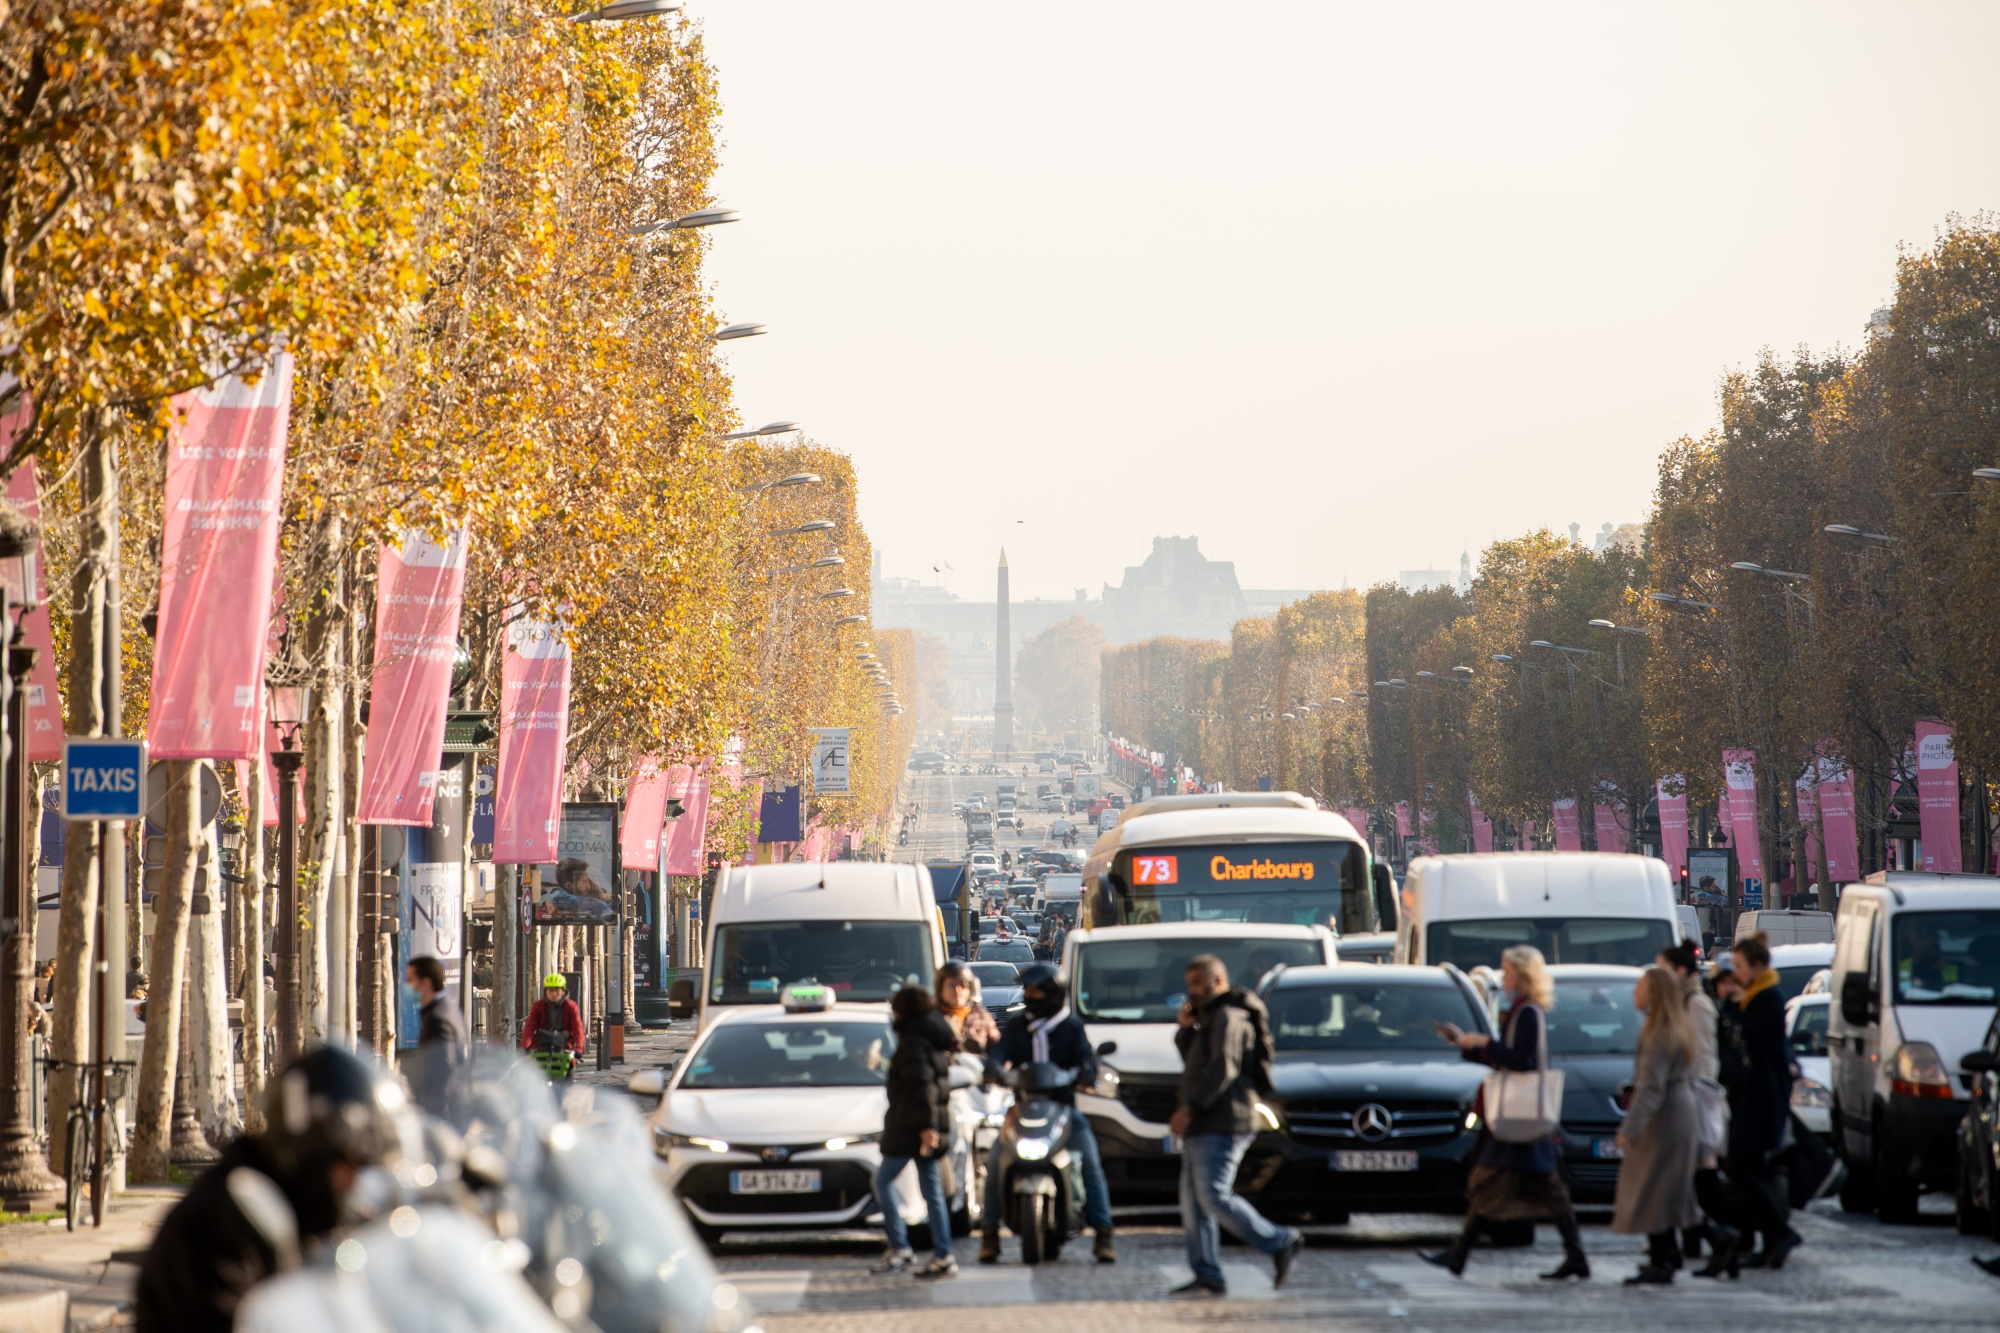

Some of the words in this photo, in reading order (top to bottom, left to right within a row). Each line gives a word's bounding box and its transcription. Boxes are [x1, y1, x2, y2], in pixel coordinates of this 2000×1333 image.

[1925, 743, 1951, 751] PARIS
[1922, 752, 1952, 760] PHOTO
[70, 767, 136, 793] TAXIS
[473, 802, 494, 816] FLA
[558, 841, 584, 853] OOD
[586, 841, 612, 853] MAN
[1138, 859, 1171, 882] 73
[1210, 855, 1315, 881] Charlebourg
[1750, 878, 1761, 891] P
